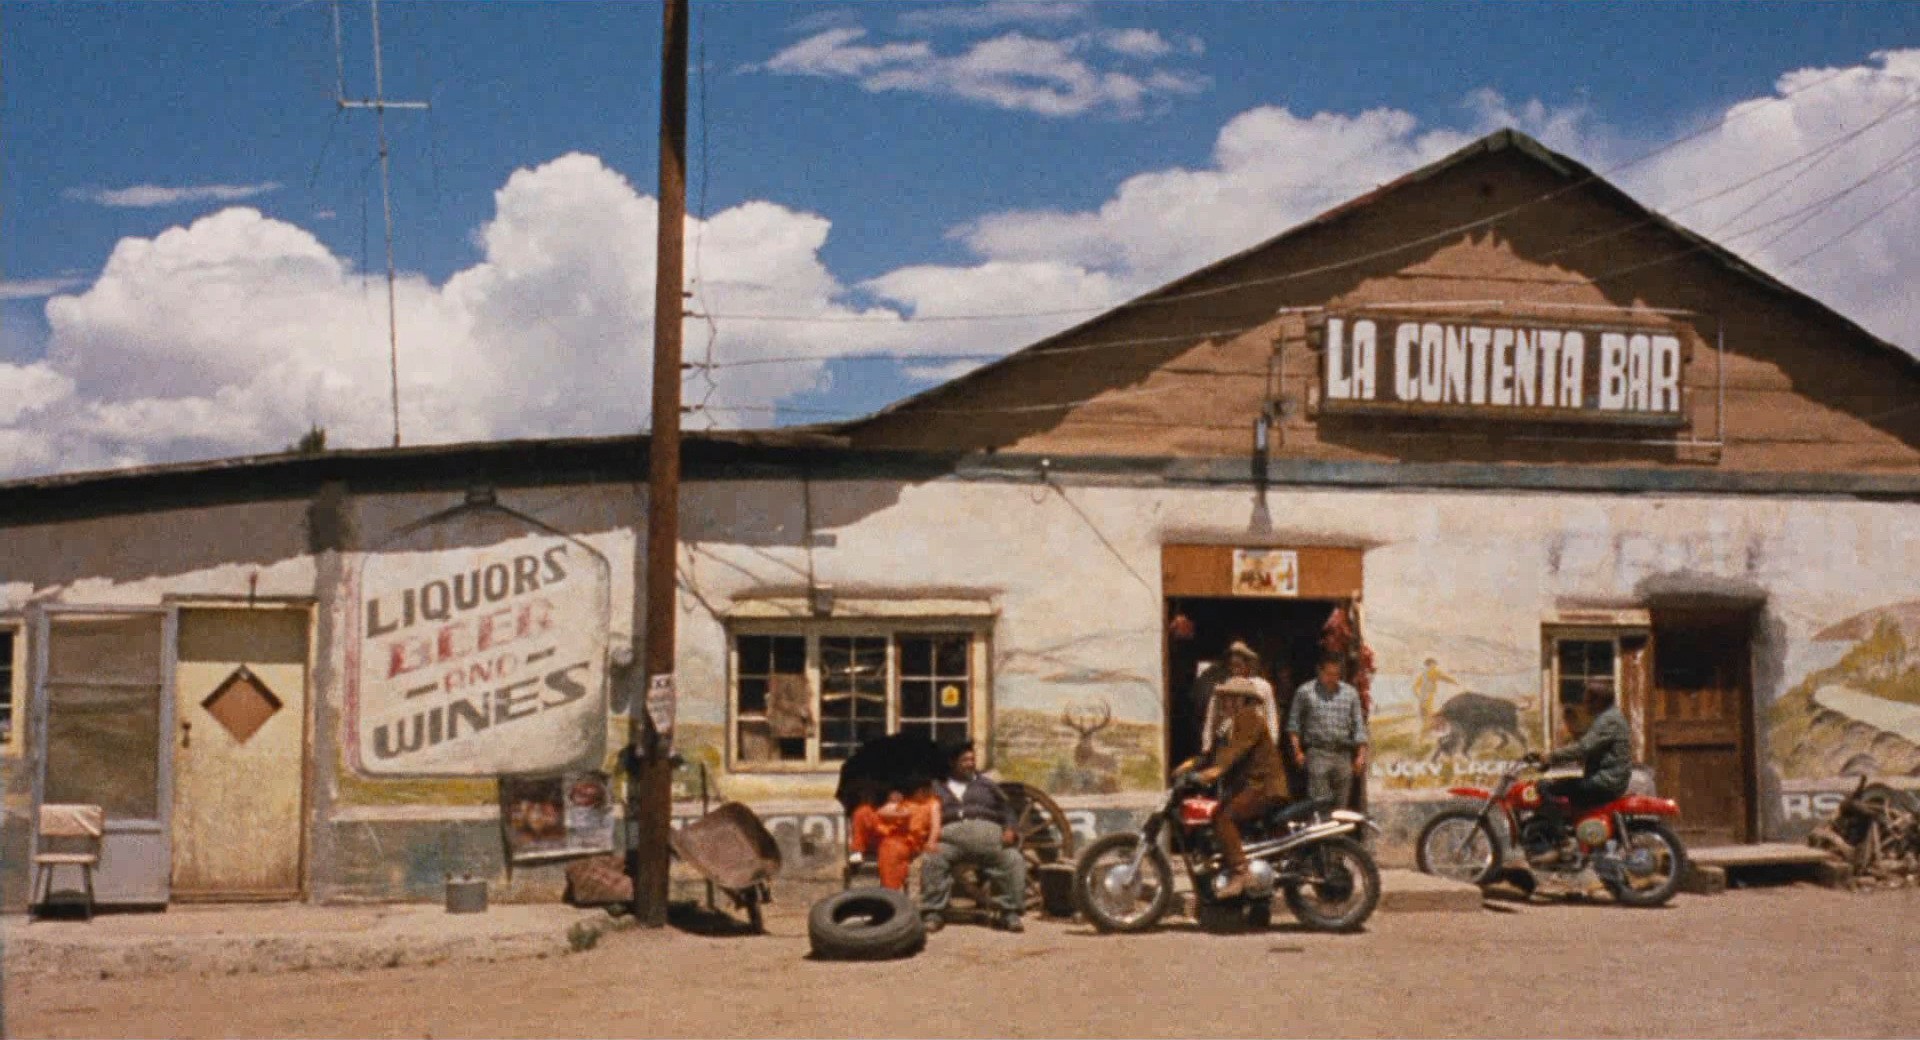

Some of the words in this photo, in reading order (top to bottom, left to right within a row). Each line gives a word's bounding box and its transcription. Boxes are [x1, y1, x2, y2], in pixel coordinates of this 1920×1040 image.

[1327, 318, 1376, 399] LA
[1395, 322, 1584, 408] CONTENTA
[1600, 333, 1680, 412] BAR
[366, 545, 568, 638] LIQUORS
[387, 599, 554, 680] BEER
[445, 652, 518, 693] AND
[373, 660, 591, 760] WINES
[1371, 759, 1443, 778] LUCKY
